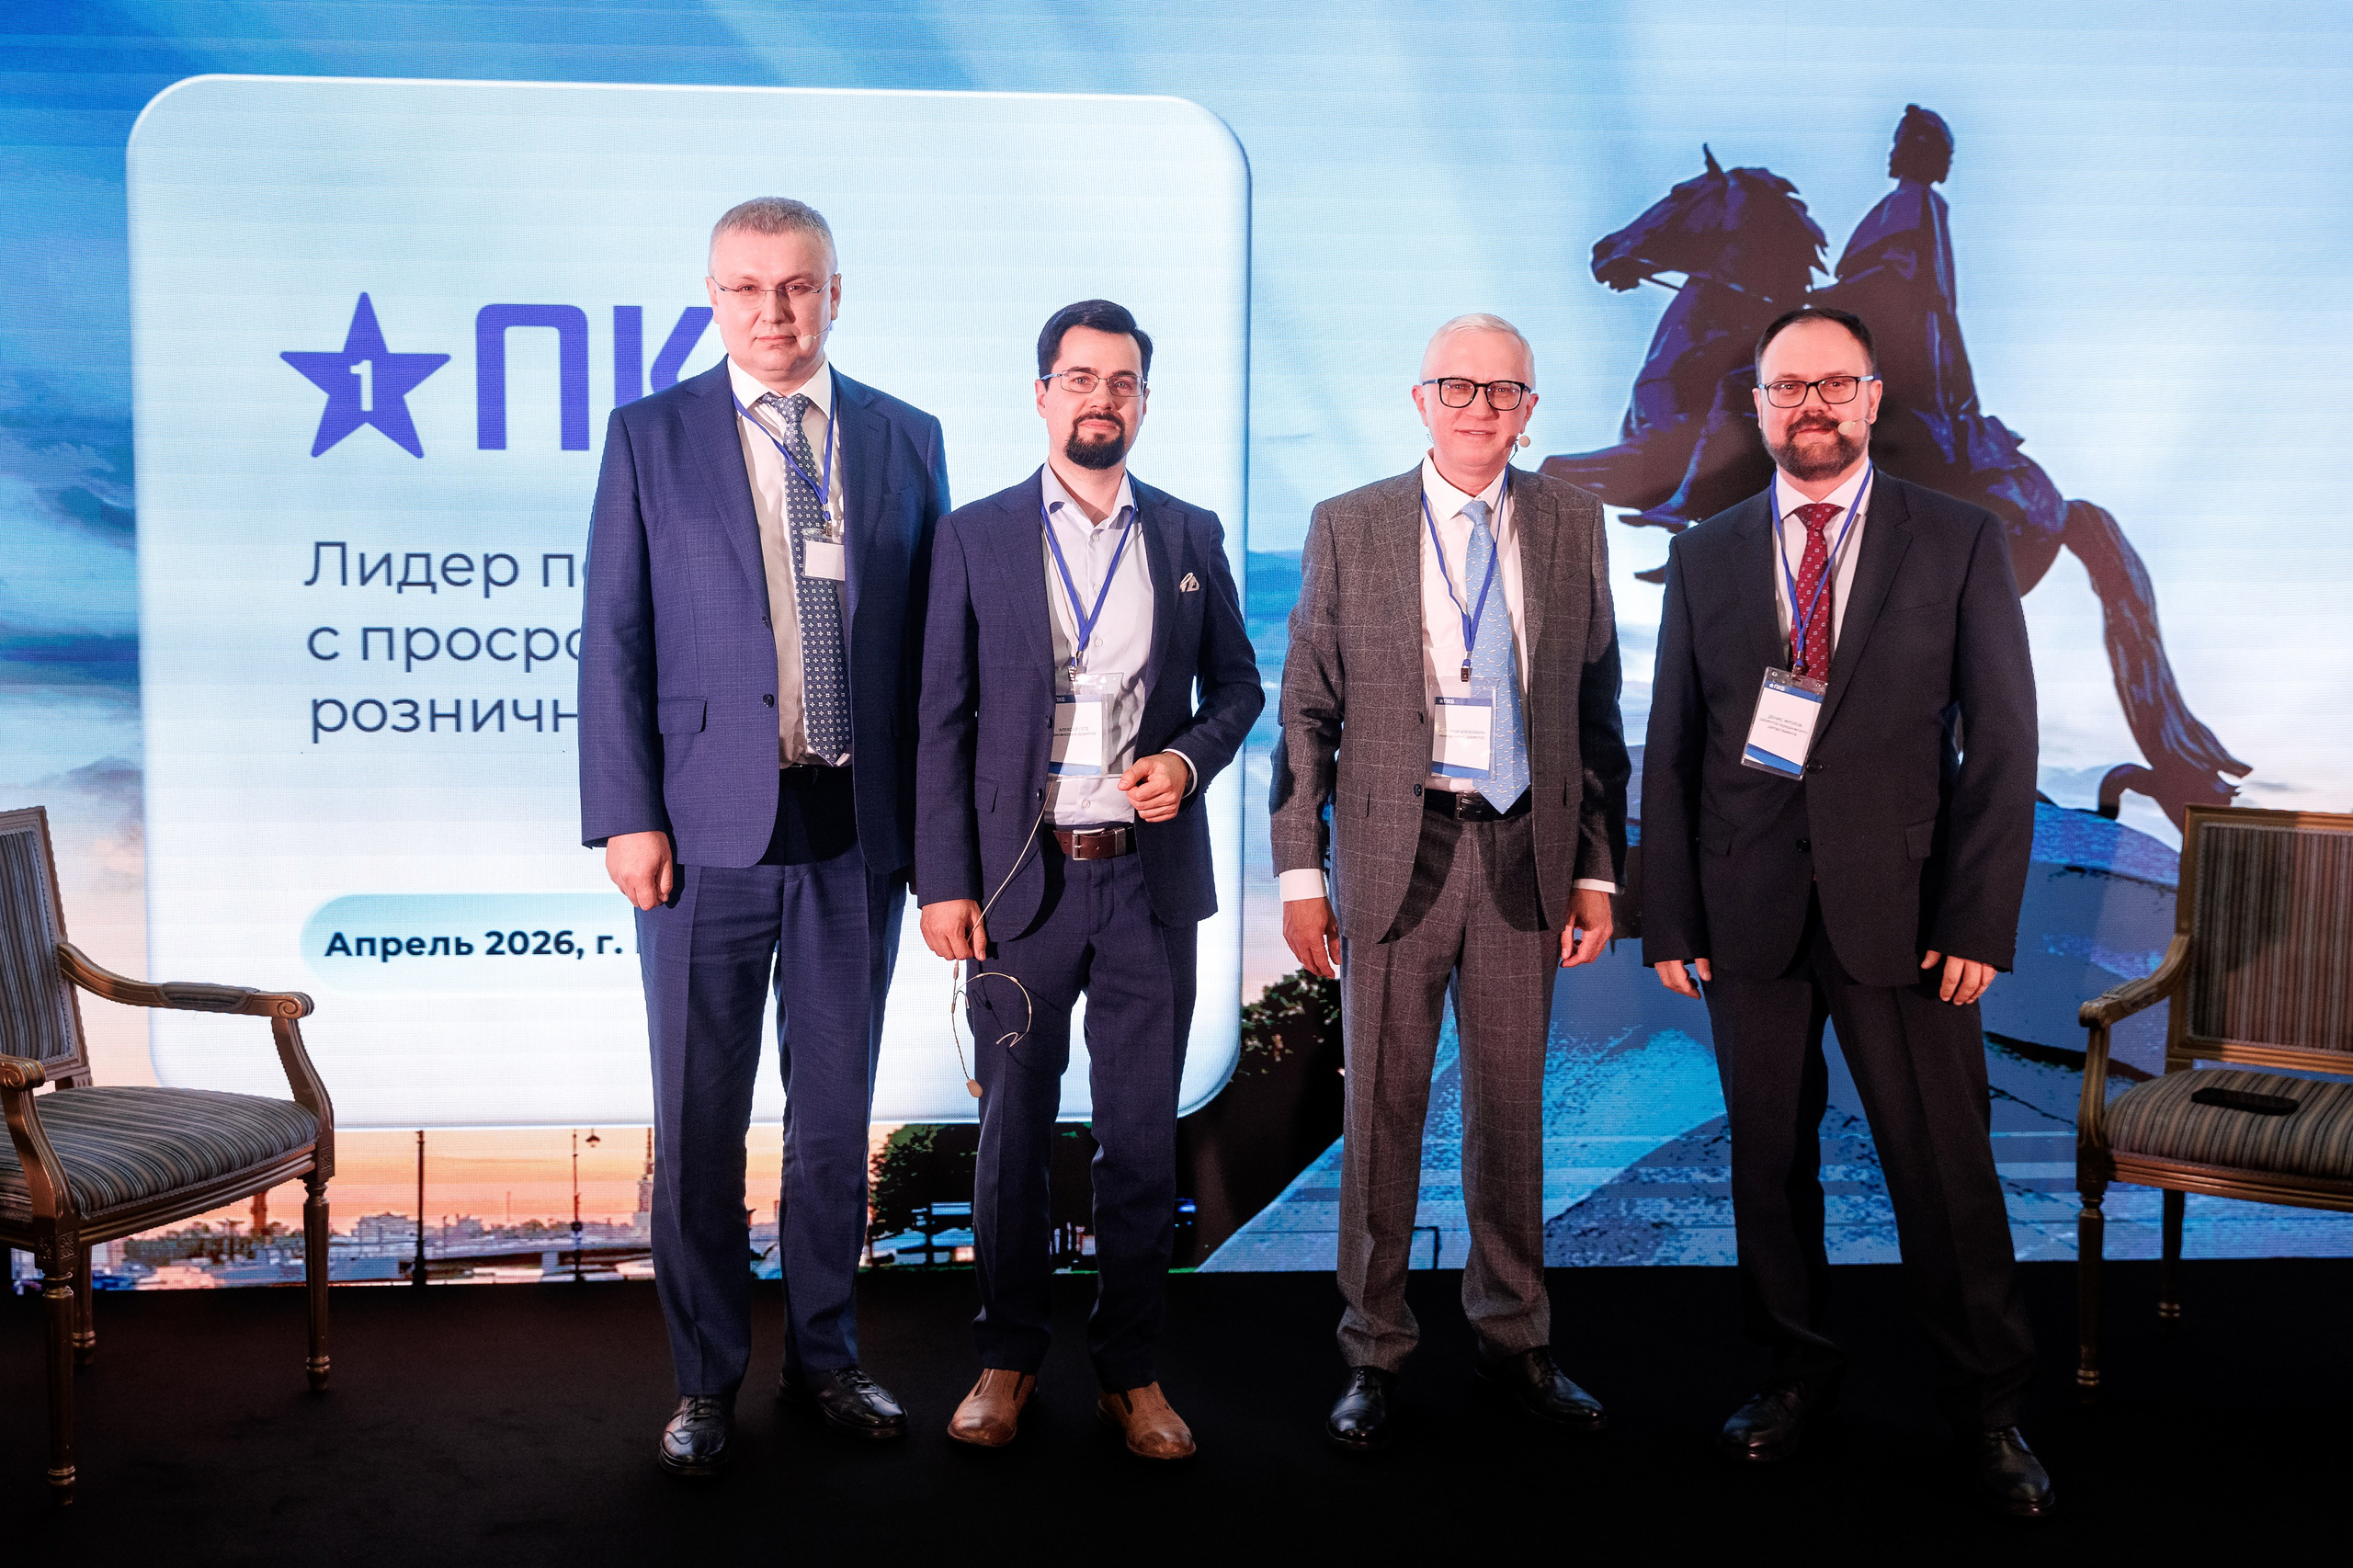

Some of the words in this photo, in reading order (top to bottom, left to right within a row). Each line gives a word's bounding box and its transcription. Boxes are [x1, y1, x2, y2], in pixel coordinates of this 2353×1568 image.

[475, 303, 714, 451] ПК
[303, 541, 519, 598] Лидер
[542, 553, 585, 587] п
[307, 627, 340, 662] с
[324, 931, 474, 962] Апрель
[484, 930, 585, 960] 2026,
[597, 935, 623, 954] г.
